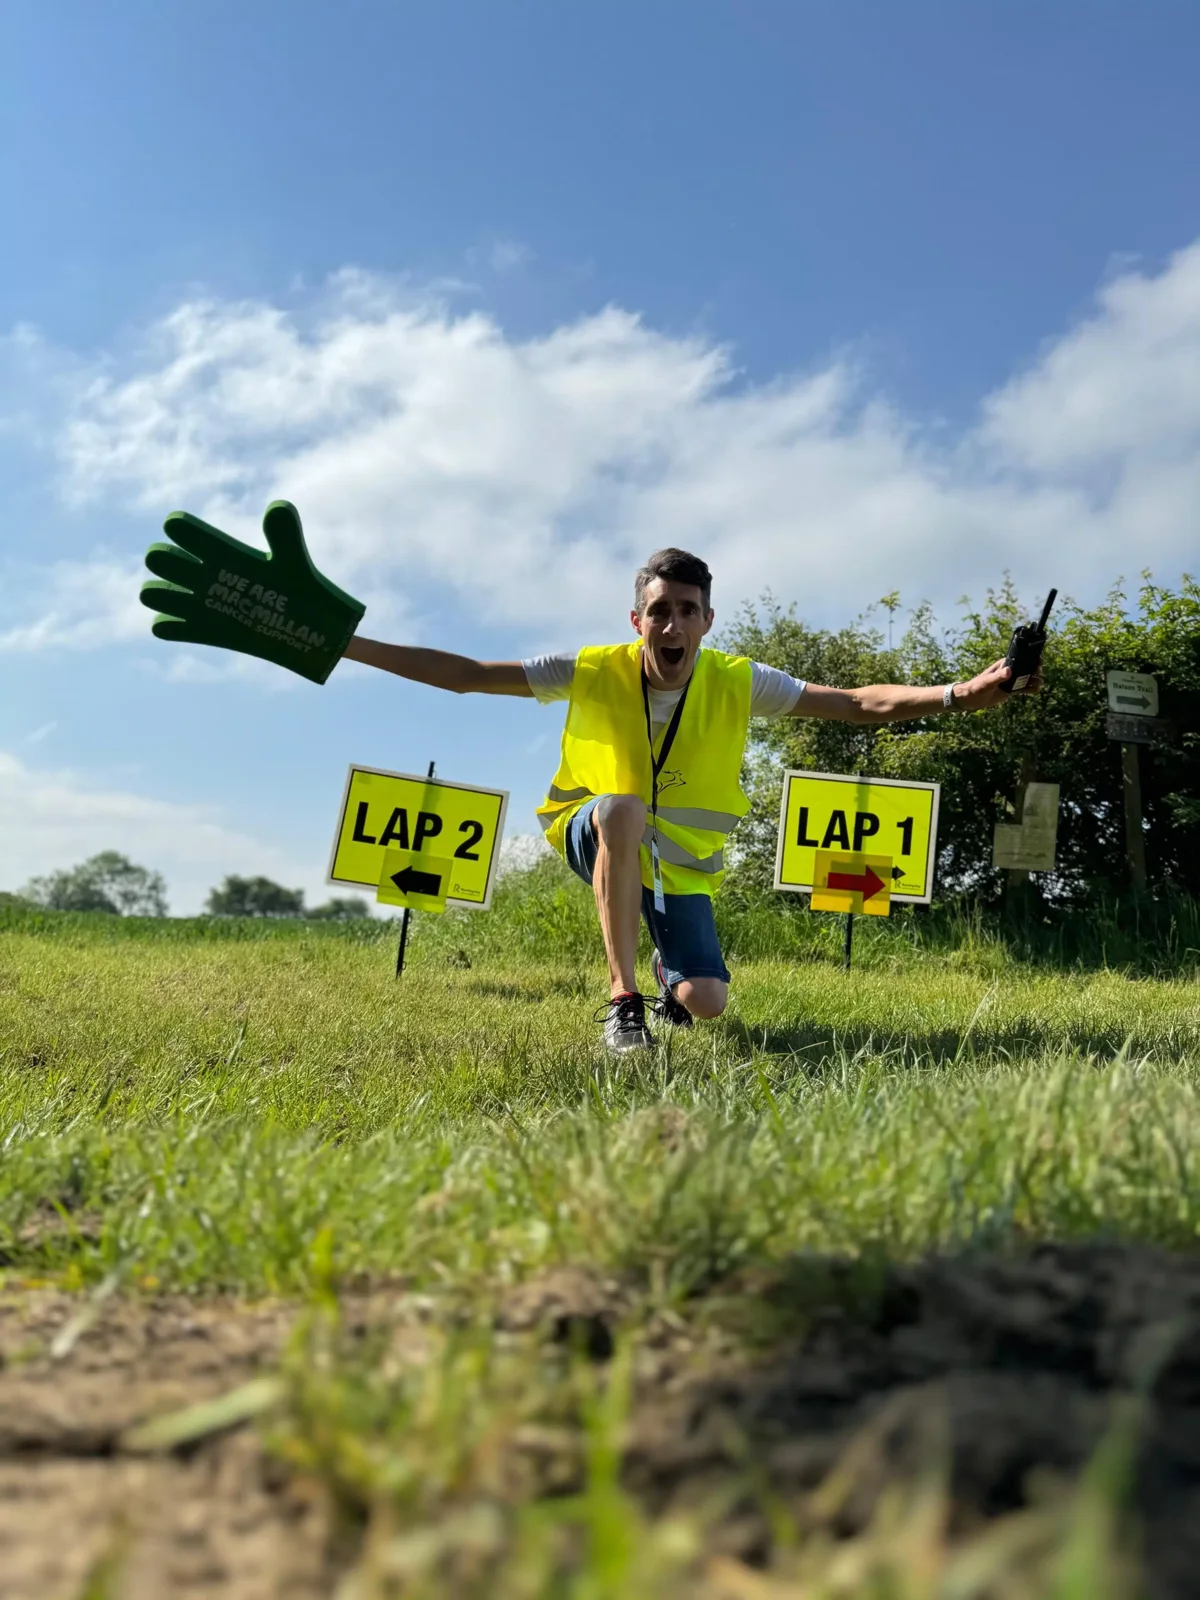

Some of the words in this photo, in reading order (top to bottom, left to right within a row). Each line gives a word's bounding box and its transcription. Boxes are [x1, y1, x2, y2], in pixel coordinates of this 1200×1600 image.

[207, 582, 326, 648] MACMILLAN
[218, 568, 250, 592] WE
[249, 583, 288, 612] ARE
[205, 598, 254, 628] CANCER
[254, 624, 313, 653] SUPPORT
[1113, 682, 1135, 691] Nature
[1137, 685, 1154, 693] Trail
[352, 801, 443, 852] LAP
[453, 820, 484, 862] 2
[797, 806, 880, 852] LAP
[896, 816, 914, 856] 1
